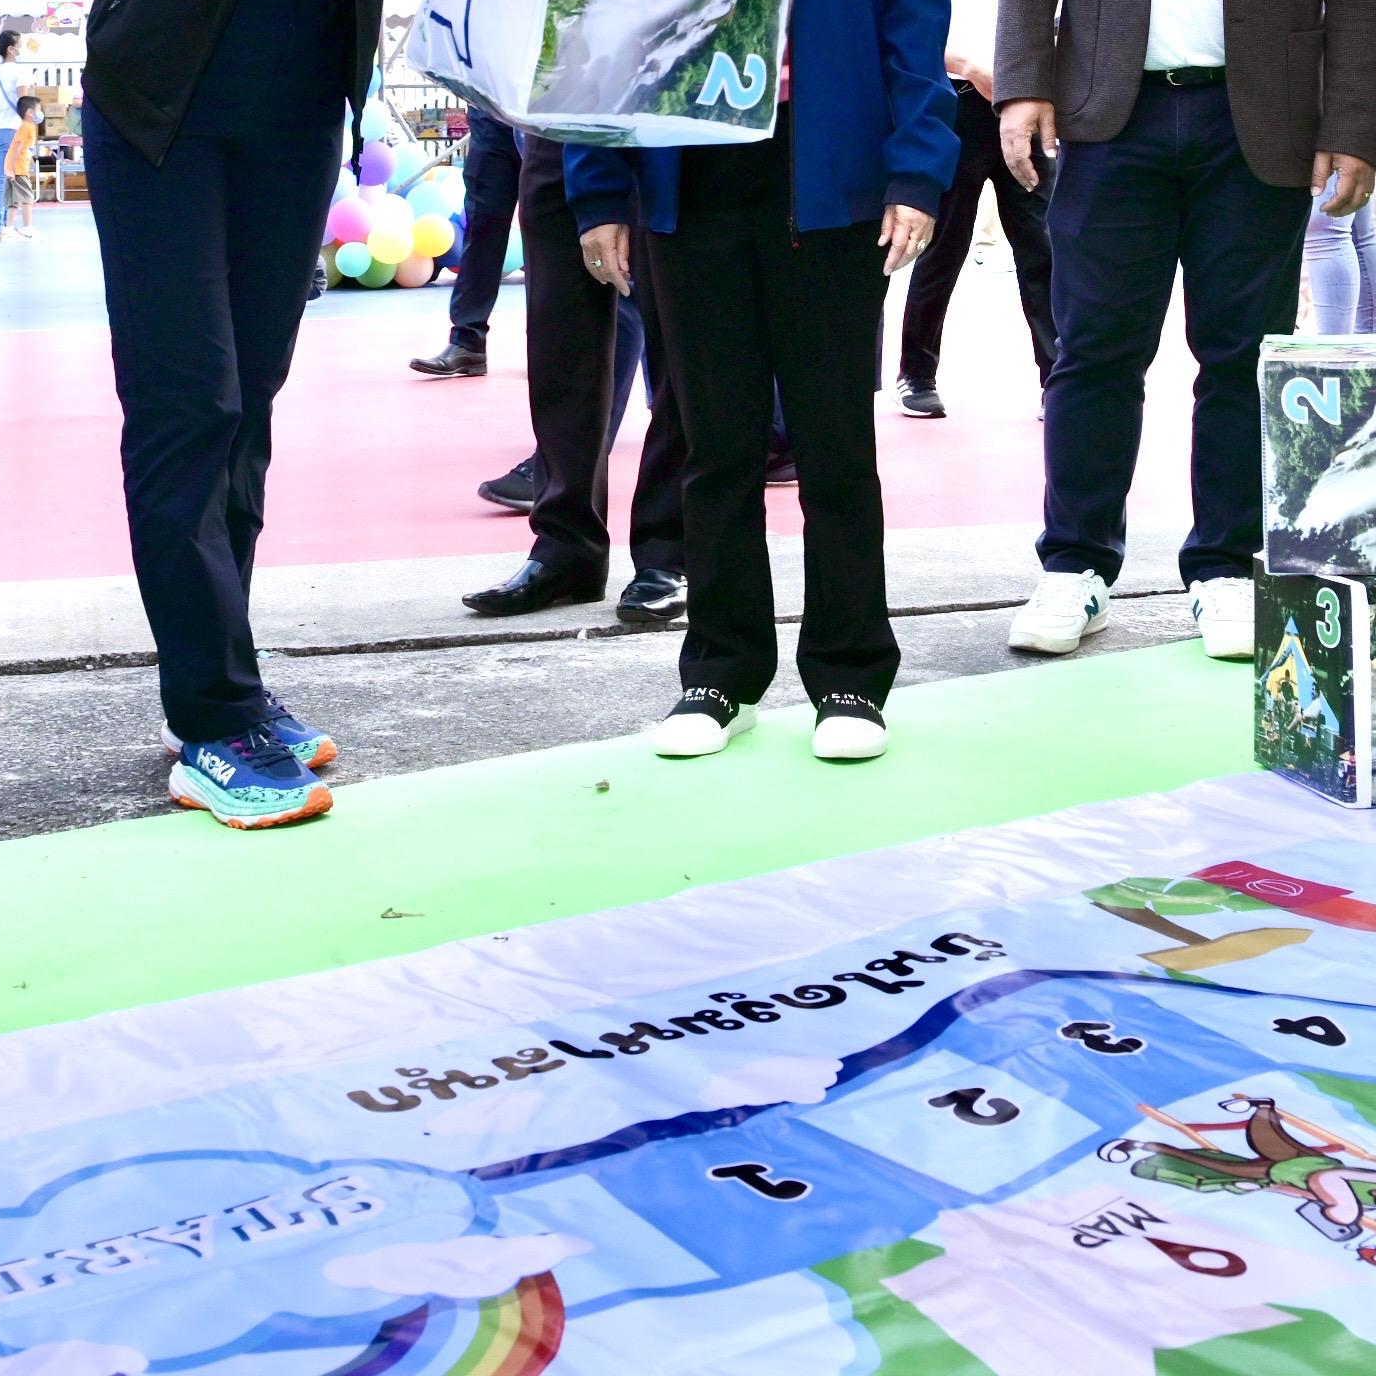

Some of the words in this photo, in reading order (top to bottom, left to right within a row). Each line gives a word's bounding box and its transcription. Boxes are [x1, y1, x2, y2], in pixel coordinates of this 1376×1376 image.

[696, 51, 768, 110] 2
[1282, 376, 1342, 426] 2
[1315, 588, 1342, 649] 3
[196, 746, 237, 787] HOKA
[346, 930, 1005, 1114] บันไดงูมหาสนุก
[1059, 1021, 1146, 1055] 3
[1273, 1015, 1350, 1047] 4
[928, 1087, 1021, 1126] 2
[709, 1164, 812, 1201] 1
[1071, 1200, 1172, 1249] MAP
